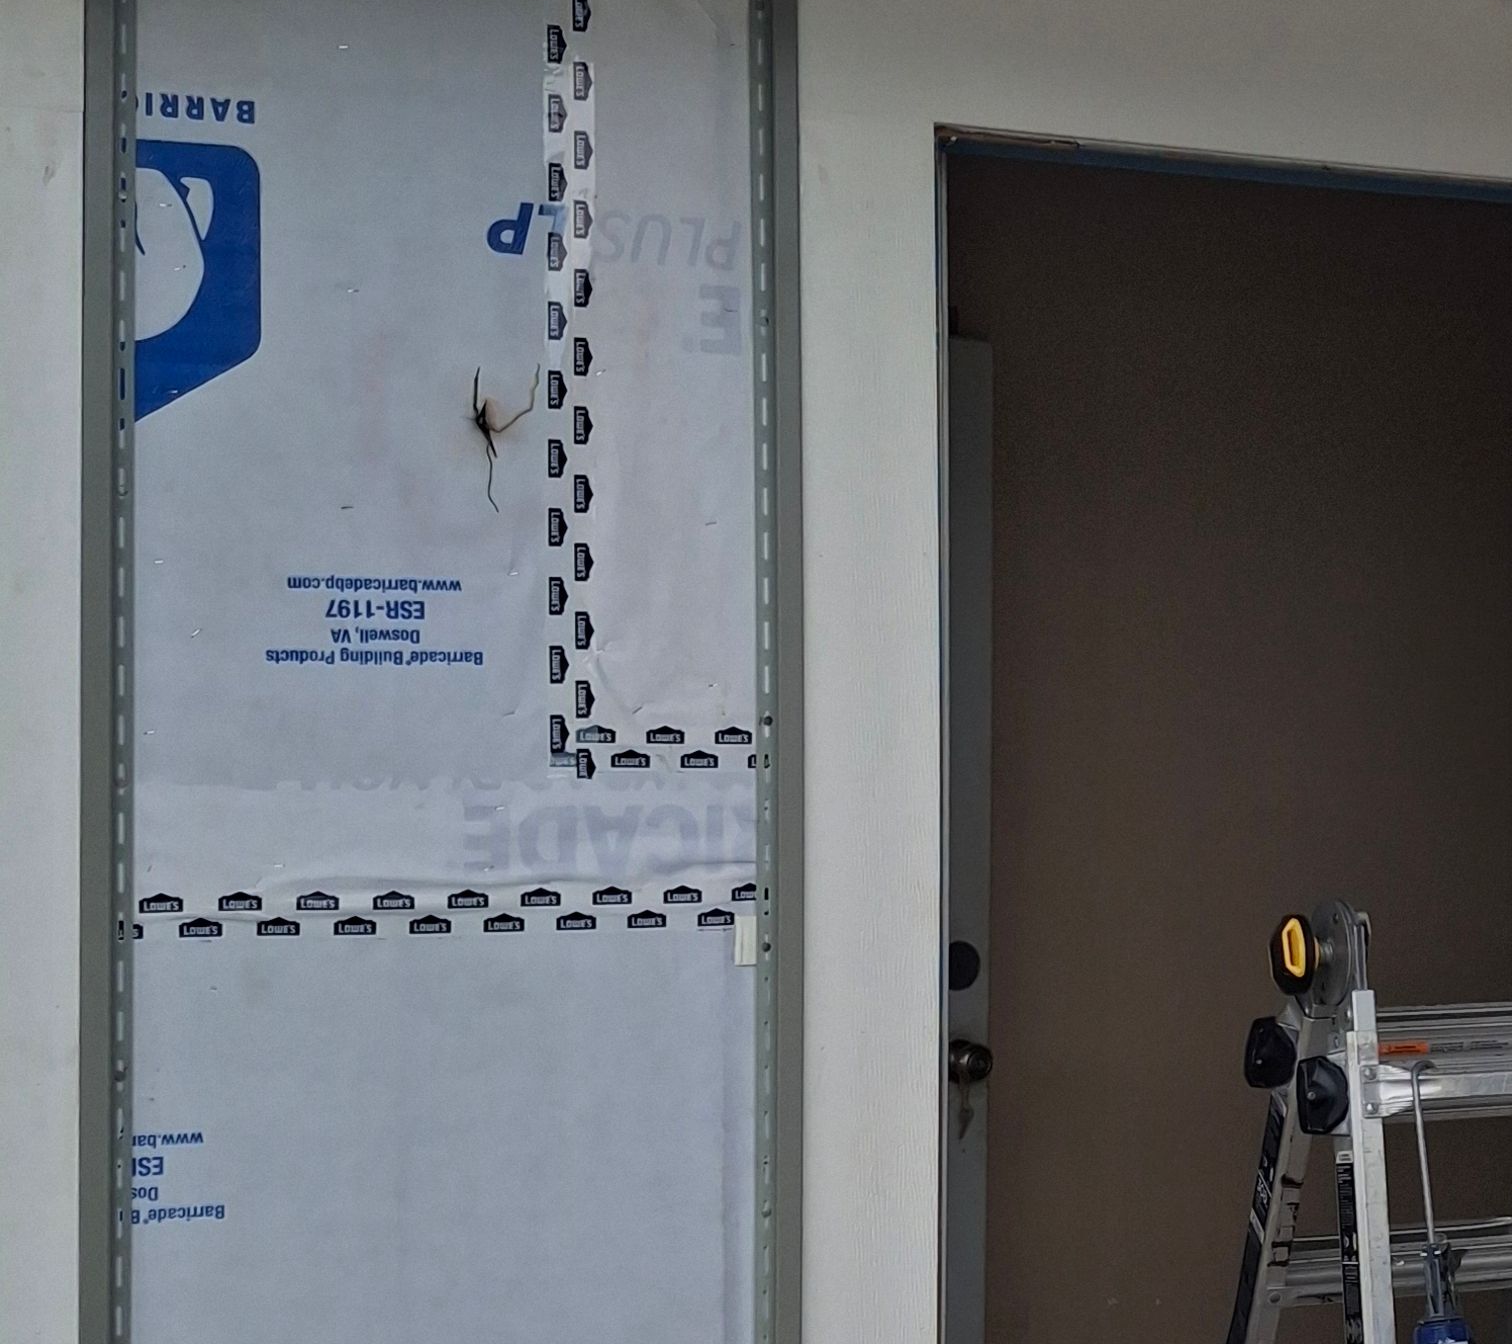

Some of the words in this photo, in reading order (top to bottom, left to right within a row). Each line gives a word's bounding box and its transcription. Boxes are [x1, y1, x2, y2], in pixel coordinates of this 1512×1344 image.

[136, 92, 255, 124] BARRI
[287, 575, 462, 593] www.barricadebp.com
[325, 599, 425, 619] ESR-1197
[331, 629, 351, 643] VA
[355, 627, 420, 644] Doswell,
[265, 649, 335, 664] Products
[340, 647, 403, 664] Building
